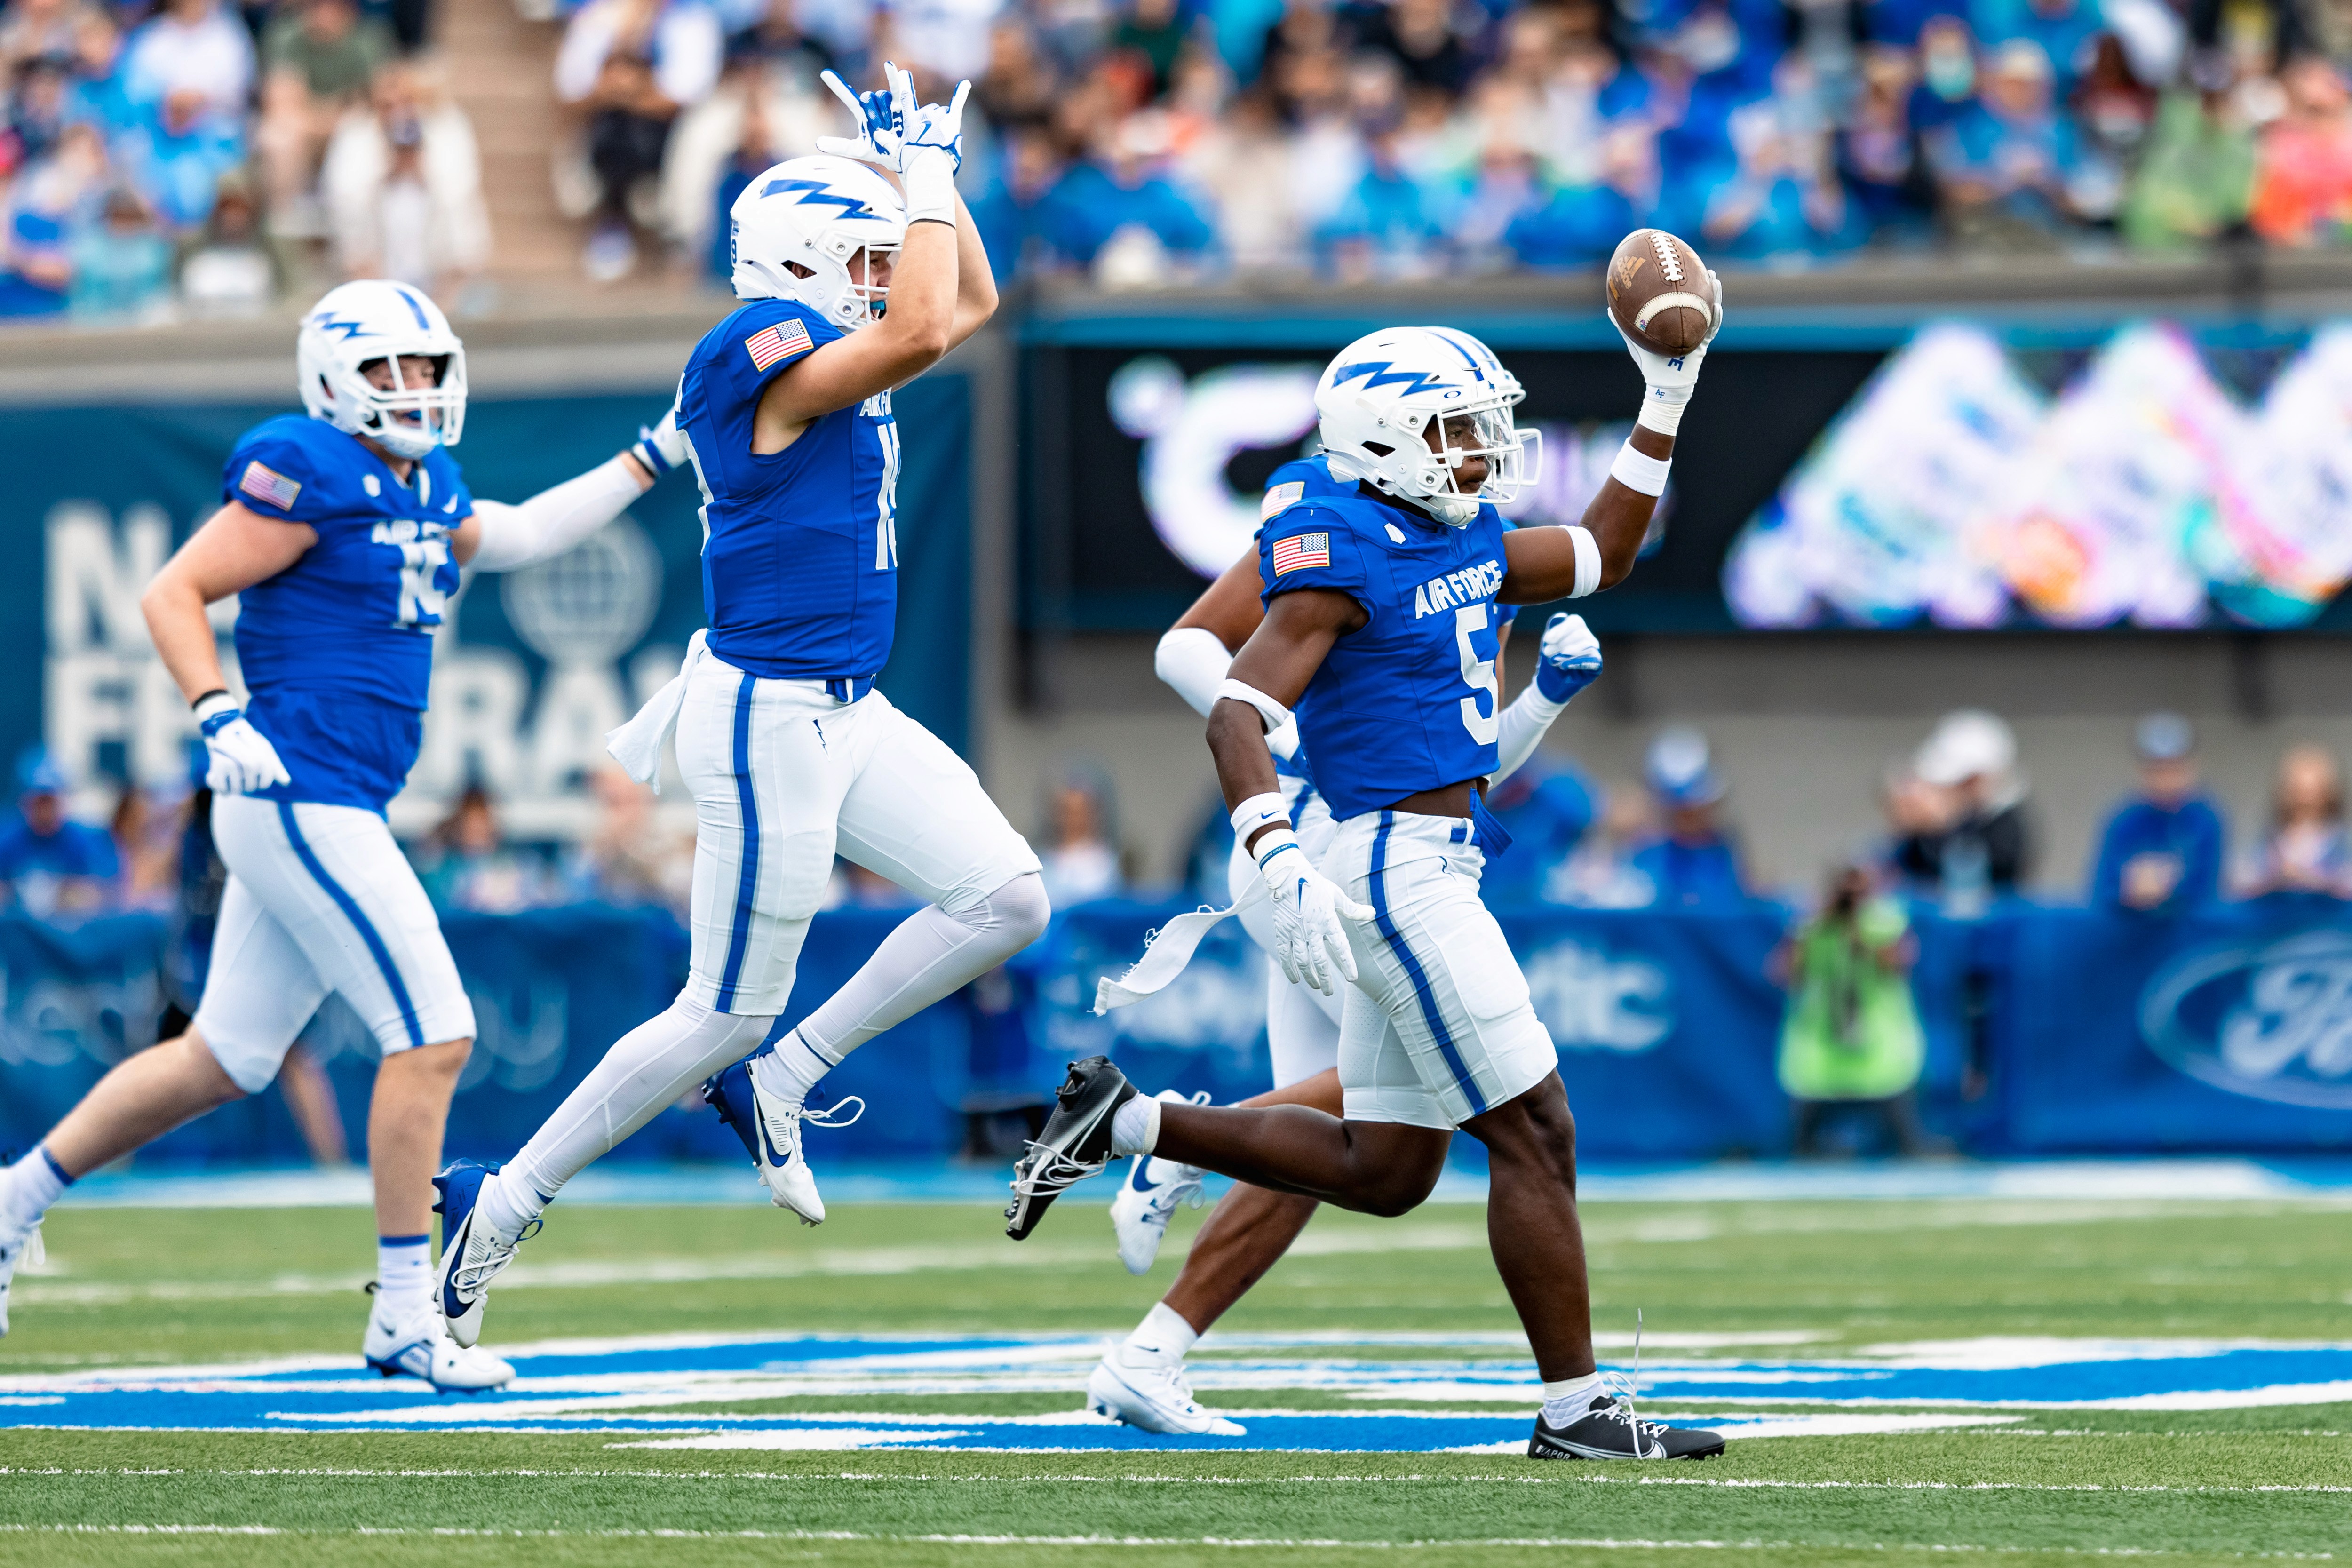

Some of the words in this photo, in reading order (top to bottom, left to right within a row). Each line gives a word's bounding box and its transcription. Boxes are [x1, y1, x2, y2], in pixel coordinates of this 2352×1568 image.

[1655, 389, 1665, 398] AF
[1415, 577, 1459, 620] AIR
[1446, 559, 1502, 603] FORCE
[1455, 603, 1498, 745] 5
